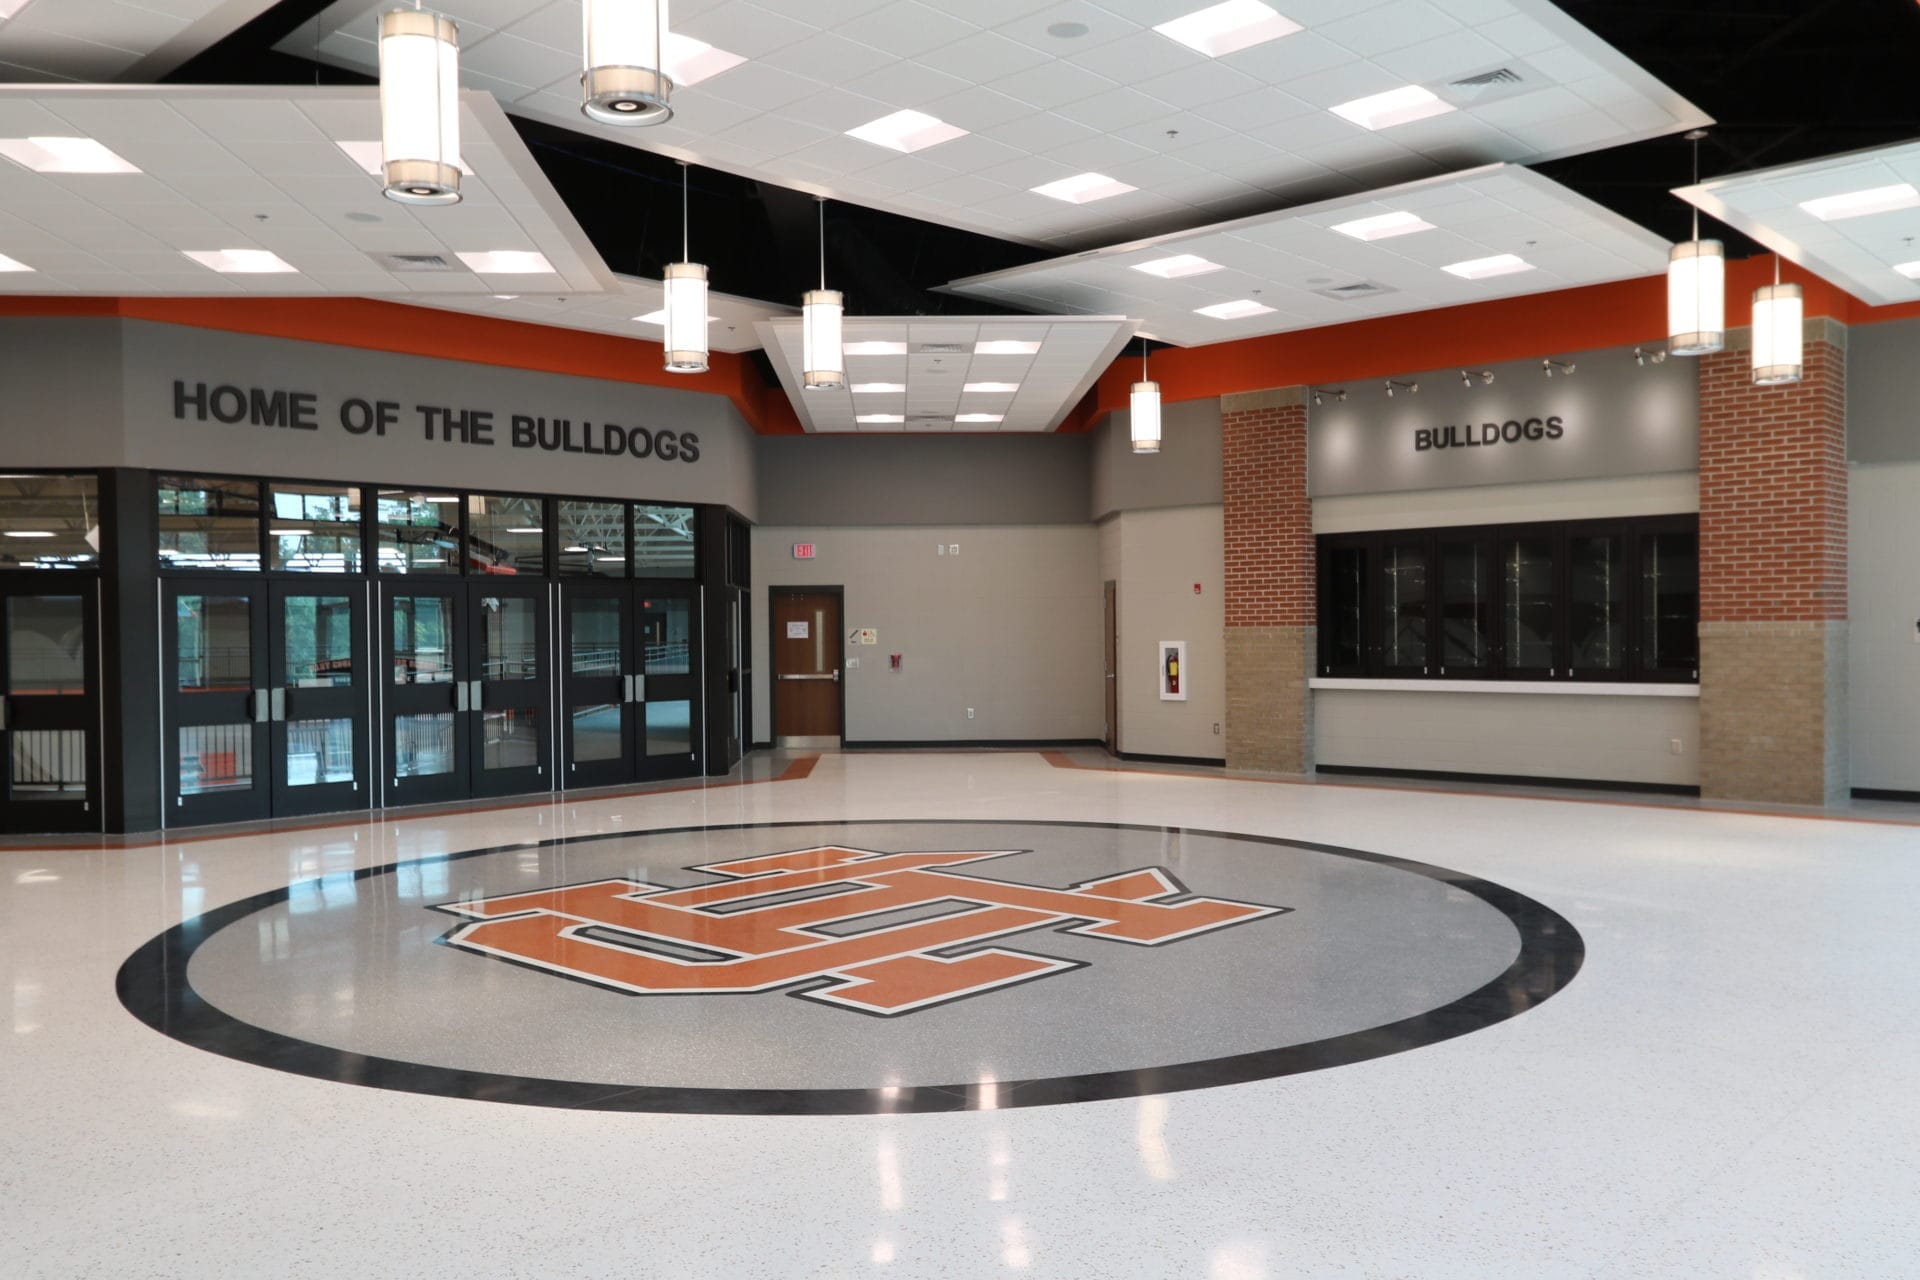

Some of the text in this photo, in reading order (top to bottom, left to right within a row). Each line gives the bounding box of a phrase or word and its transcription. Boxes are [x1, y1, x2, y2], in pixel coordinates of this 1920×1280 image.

[173, 380, 700, 463] HOME OF THE BULLDOGS
[1416, 417, 1562, 450] BULLDOGS
